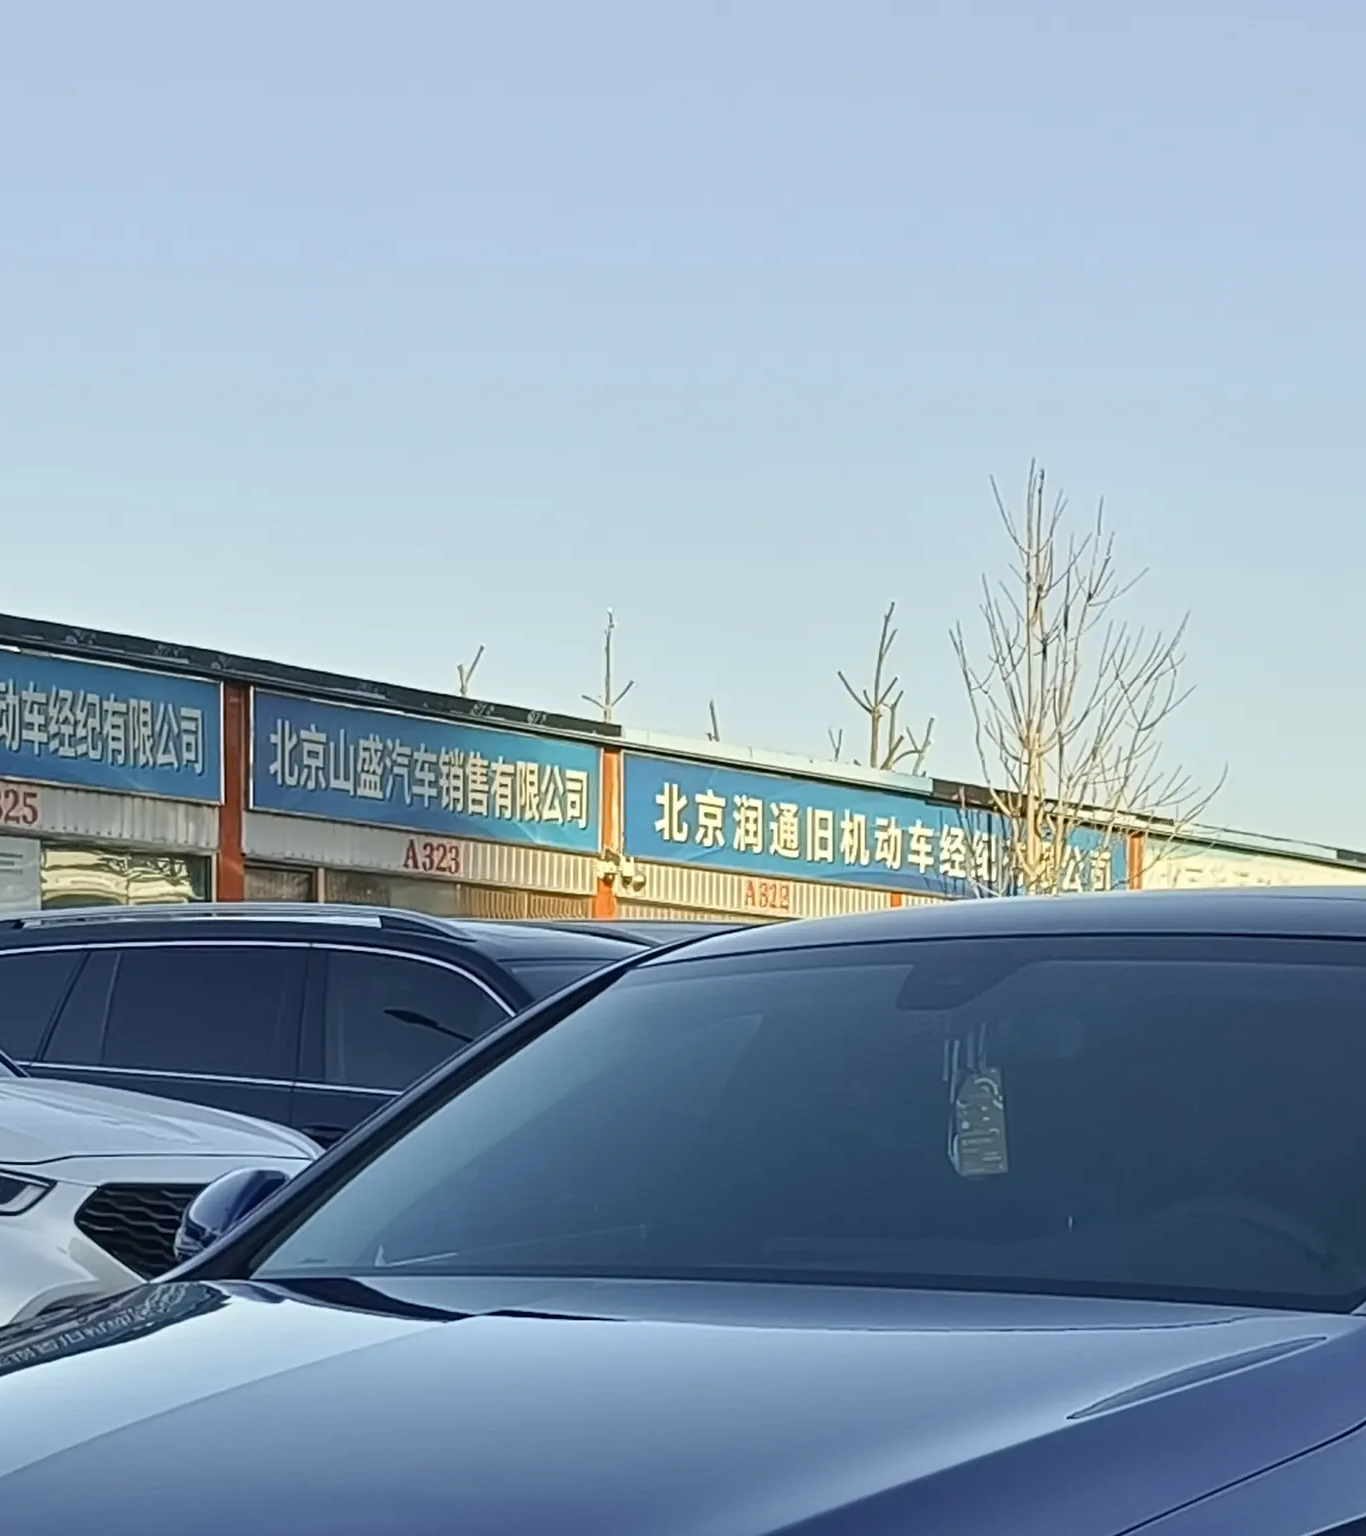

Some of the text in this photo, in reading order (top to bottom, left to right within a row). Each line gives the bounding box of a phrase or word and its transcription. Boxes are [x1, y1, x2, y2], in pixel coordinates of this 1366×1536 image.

[269, 719, 588, 828] 北京山盛汽车销售有限公司
[403, 839, 460, 874] A323
